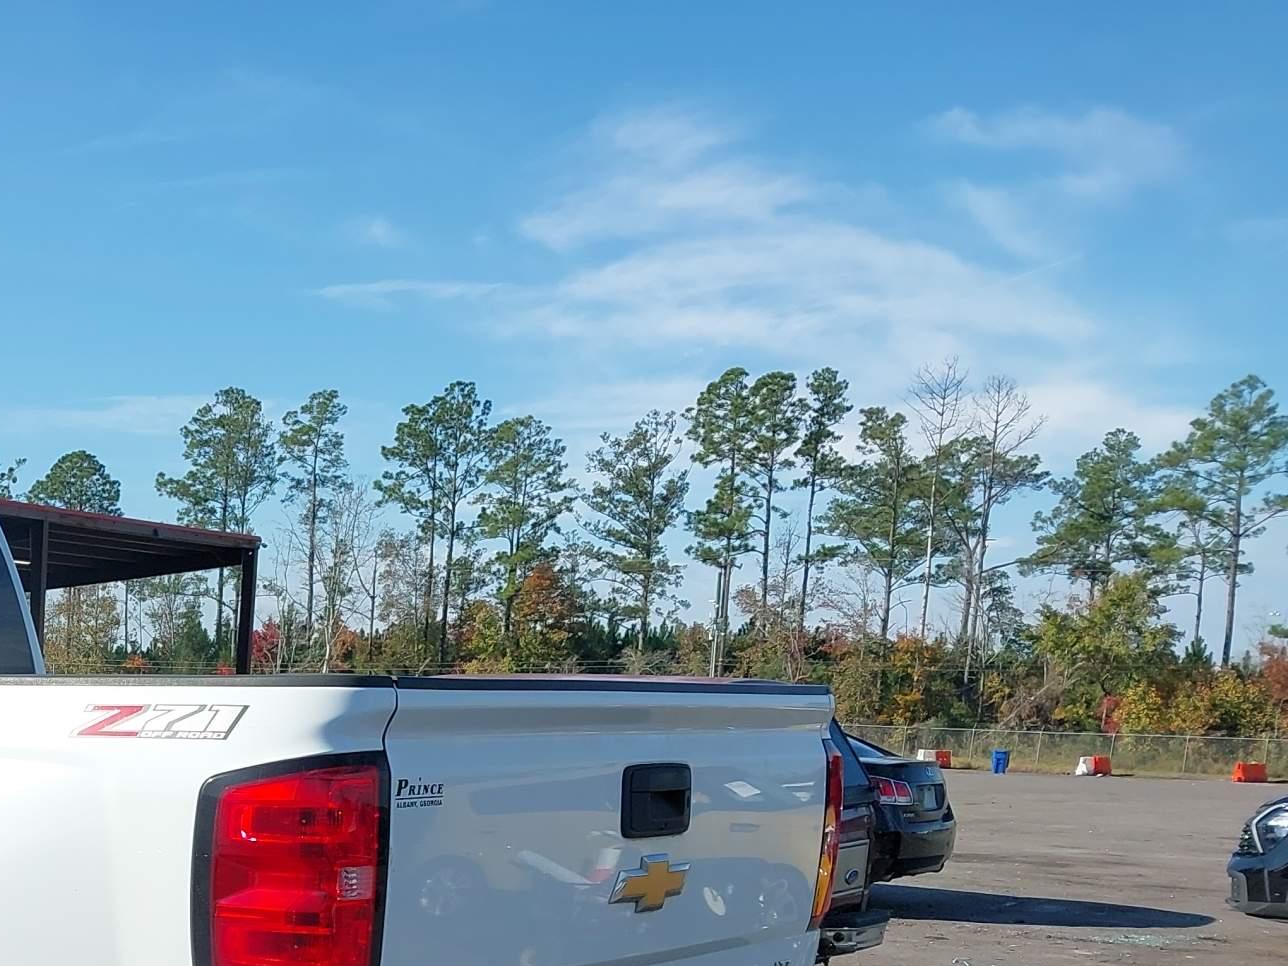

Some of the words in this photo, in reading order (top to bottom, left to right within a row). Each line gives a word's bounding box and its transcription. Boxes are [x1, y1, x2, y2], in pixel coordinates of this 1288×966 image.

[69, 704, 250, 738] Z71
[138, 730, 173, 739] OFF
[174, 731, 228, 740] ROAD
